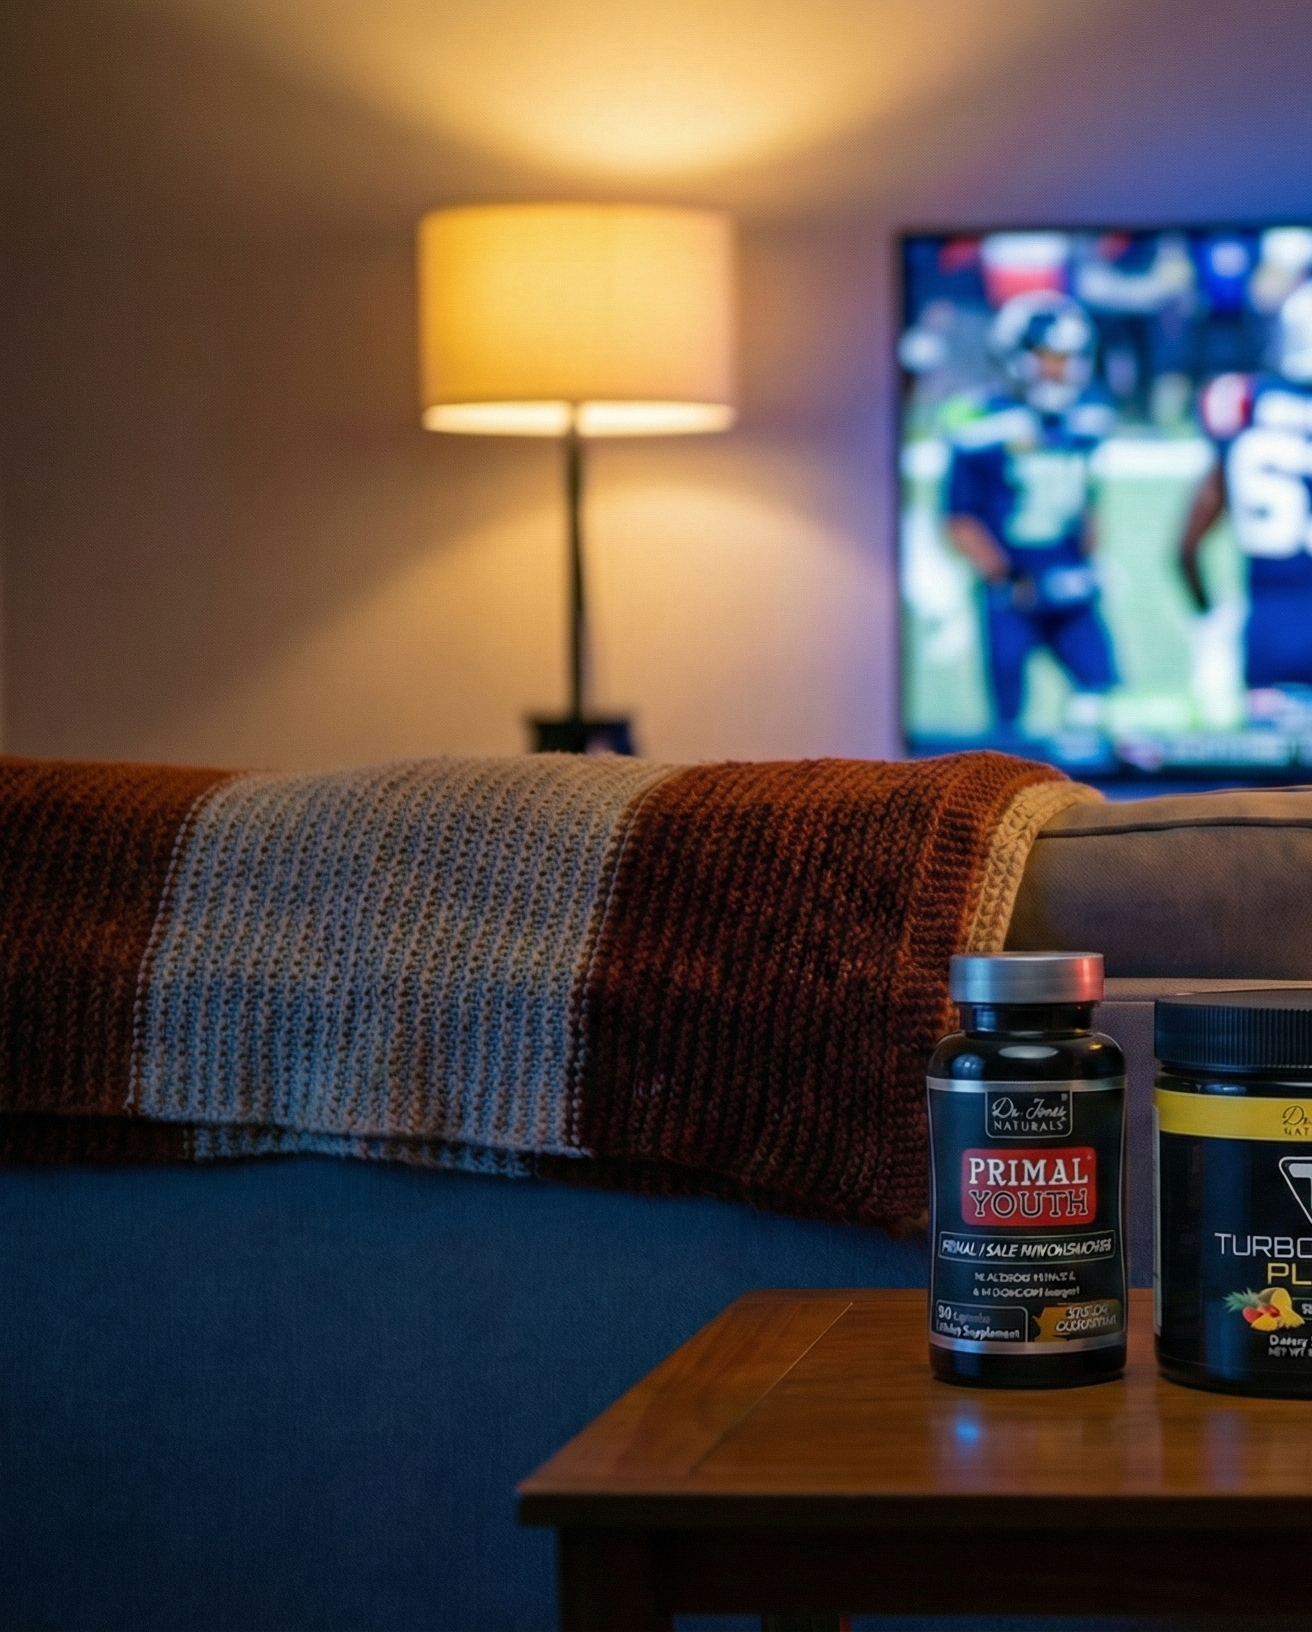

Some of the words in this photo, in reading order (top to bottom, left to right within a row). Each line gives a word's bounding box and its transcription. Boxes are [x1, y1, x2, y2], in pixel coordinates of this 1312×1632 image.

[994, 1120, 1064, 1132] NATURALS
[969, 1157, 1089, 1186] PRIMAL
[969, 1188, 1089, 1218] YOUTH
